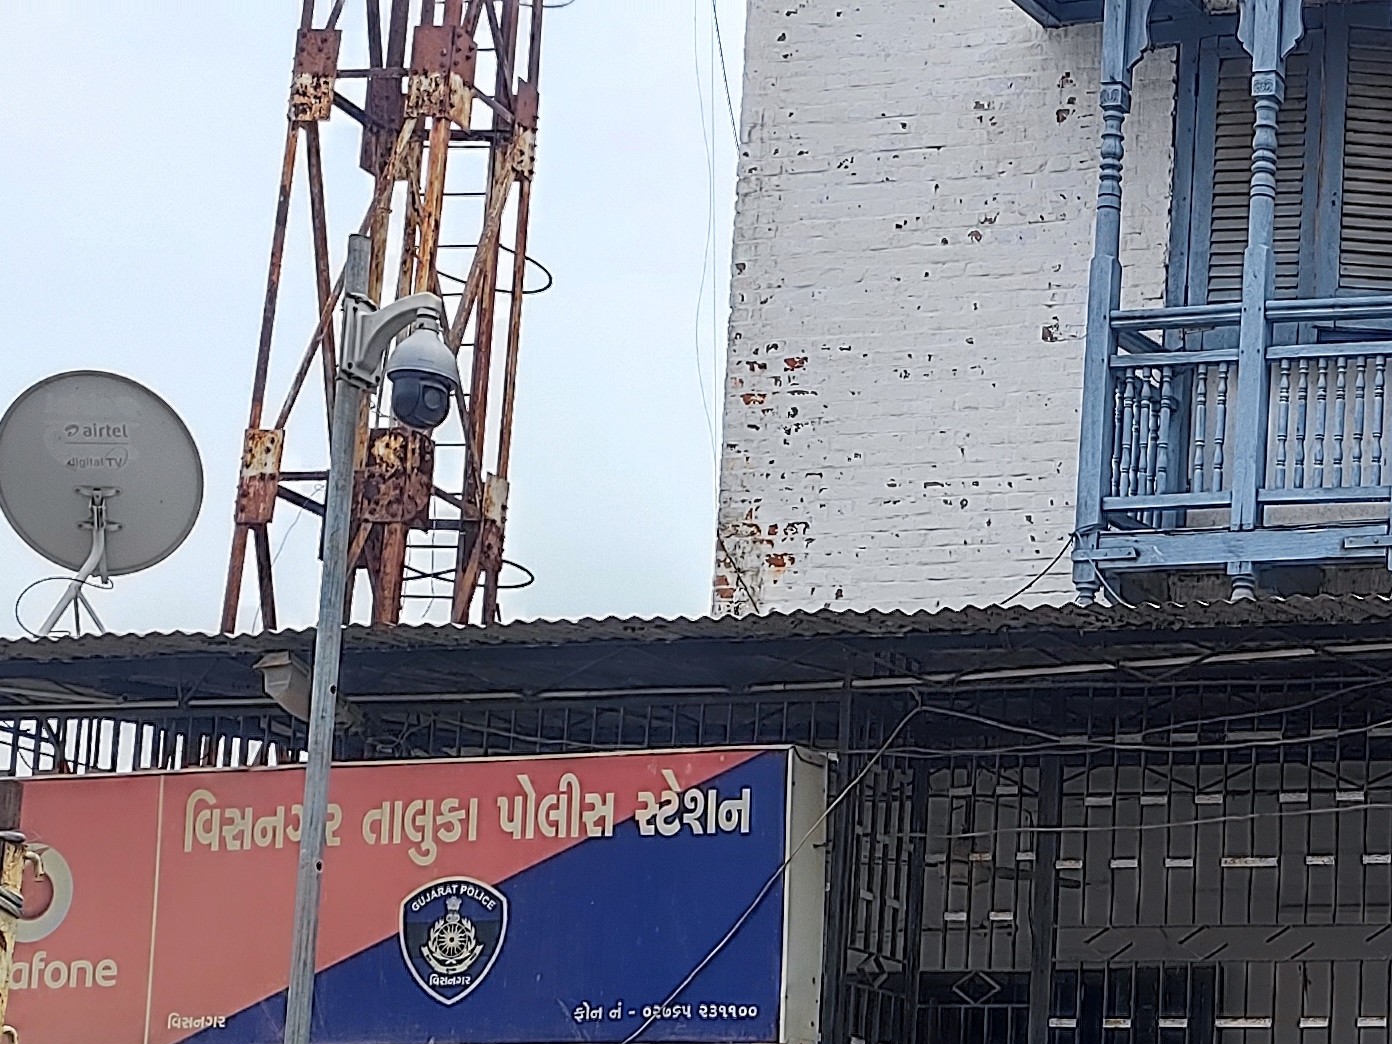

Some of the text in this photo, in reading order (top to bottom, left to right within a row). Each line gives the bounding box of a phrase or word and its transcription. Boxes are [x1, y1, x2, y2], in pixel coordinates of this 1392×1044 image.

[82, 423, 129, 438] airtel
[184, 769, 751, 866] વિસનગર તાલુકા પોલીસ સ્ટેશન
[411, 883, 497, 911] GUJARAT POLICE
[9, 951, 118, 990] afone
[429, 973, 471, 986] વિસનગર
[167, 1012, 226, 1029] વિસનગર
[573, 1002, 603, 1023] ફોન
[698, 1004, 758, 1018] ૨૩૧૧૦૦
